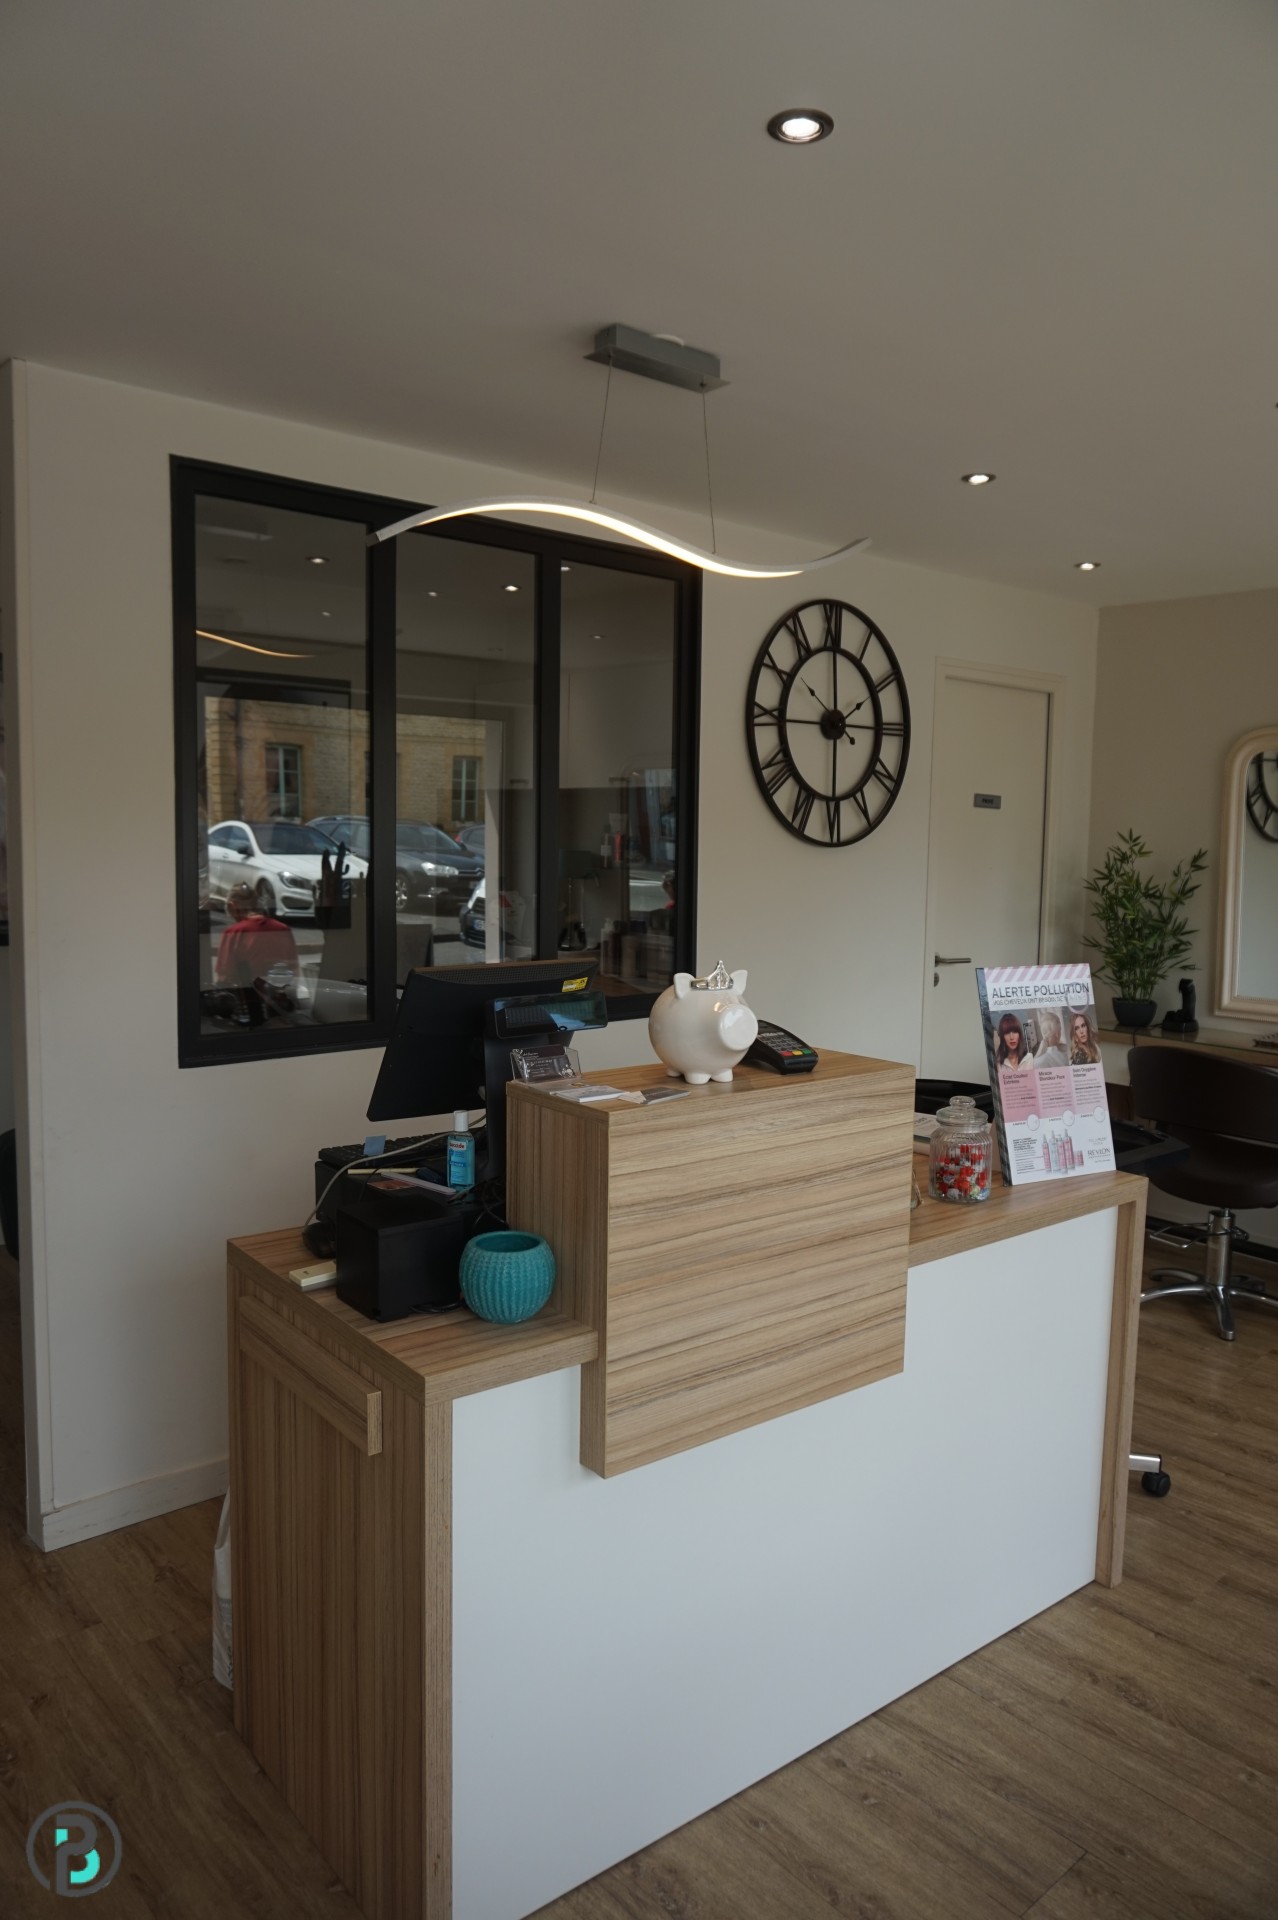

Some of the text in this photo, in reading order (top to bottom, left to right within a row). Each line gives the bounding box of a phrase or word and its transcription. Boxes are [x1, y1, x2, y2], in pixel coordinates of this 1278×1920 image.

[992, 983, 1090, 999] ALERTE POLLUTION
[1087, 1149, 1110, 1157] REVLON
